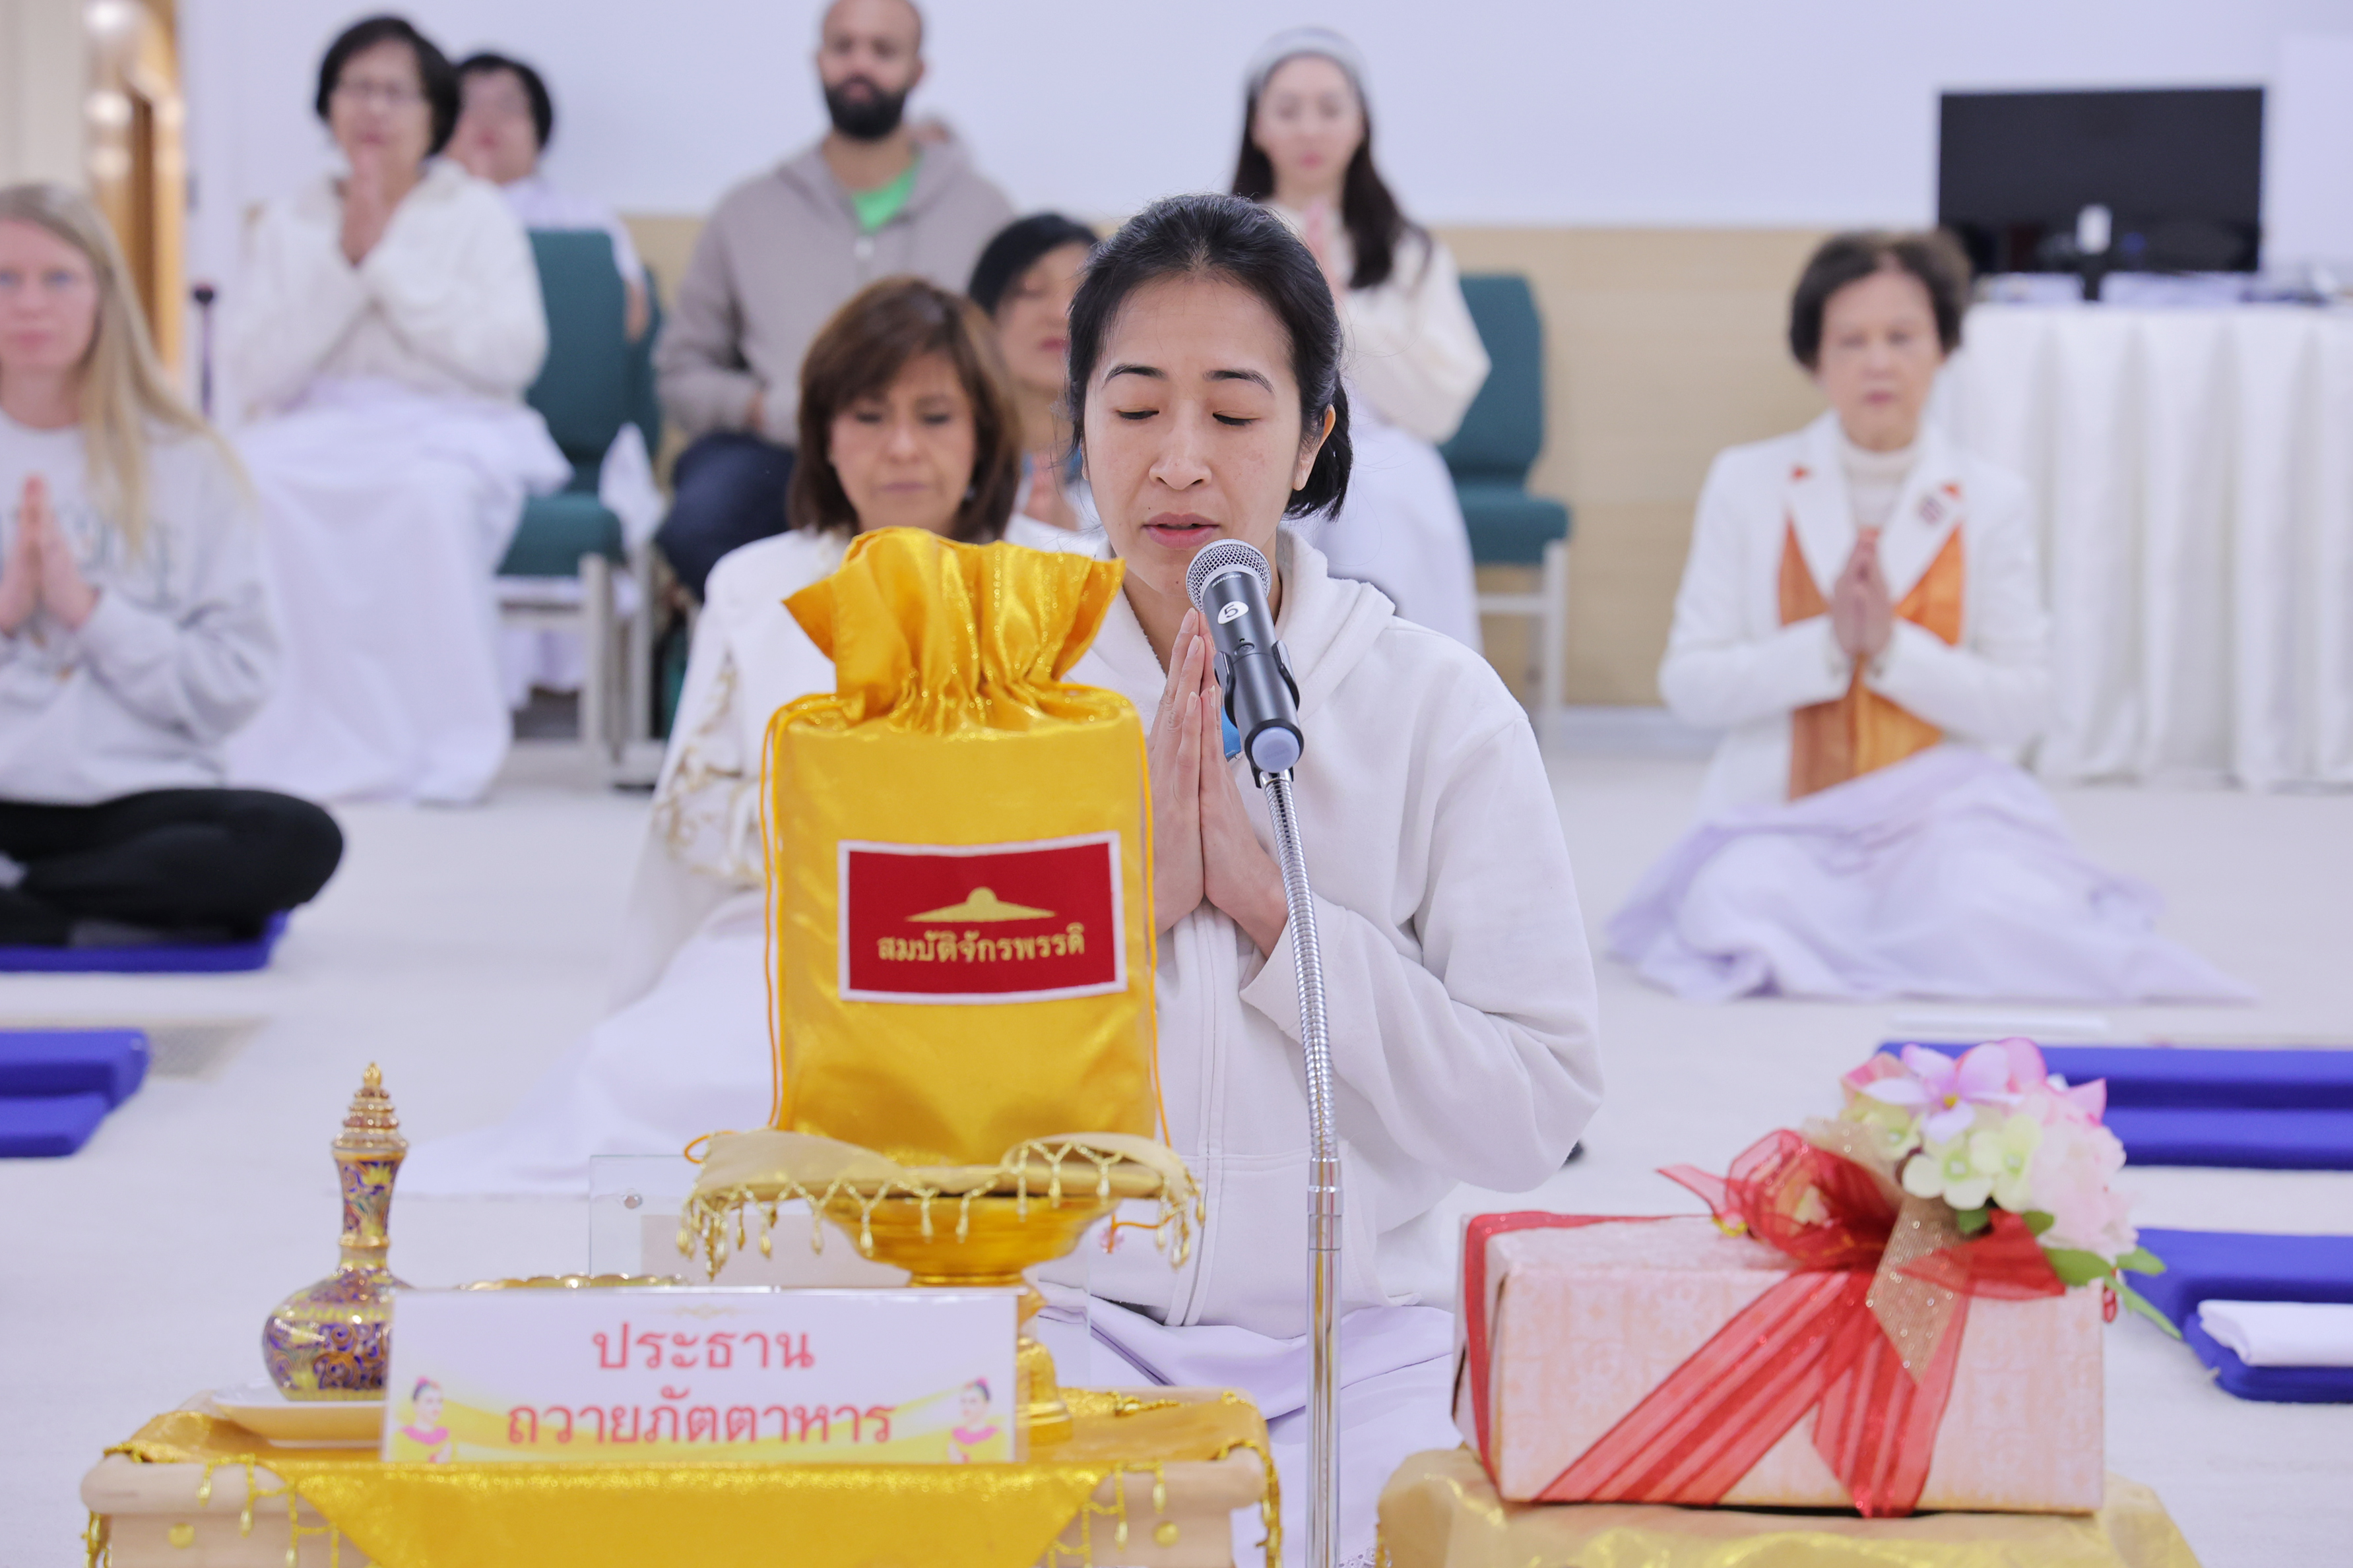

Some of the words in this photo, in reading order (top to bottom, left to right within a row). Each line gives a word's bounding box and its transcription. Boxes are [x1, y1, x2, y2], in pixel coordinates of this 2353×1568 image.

[1224, 604, 1239, 618] 5
[592, 1321, 815, 1369] ประธาน
[507, 1385, 895, 1444] ถวายภัตตาหาร
